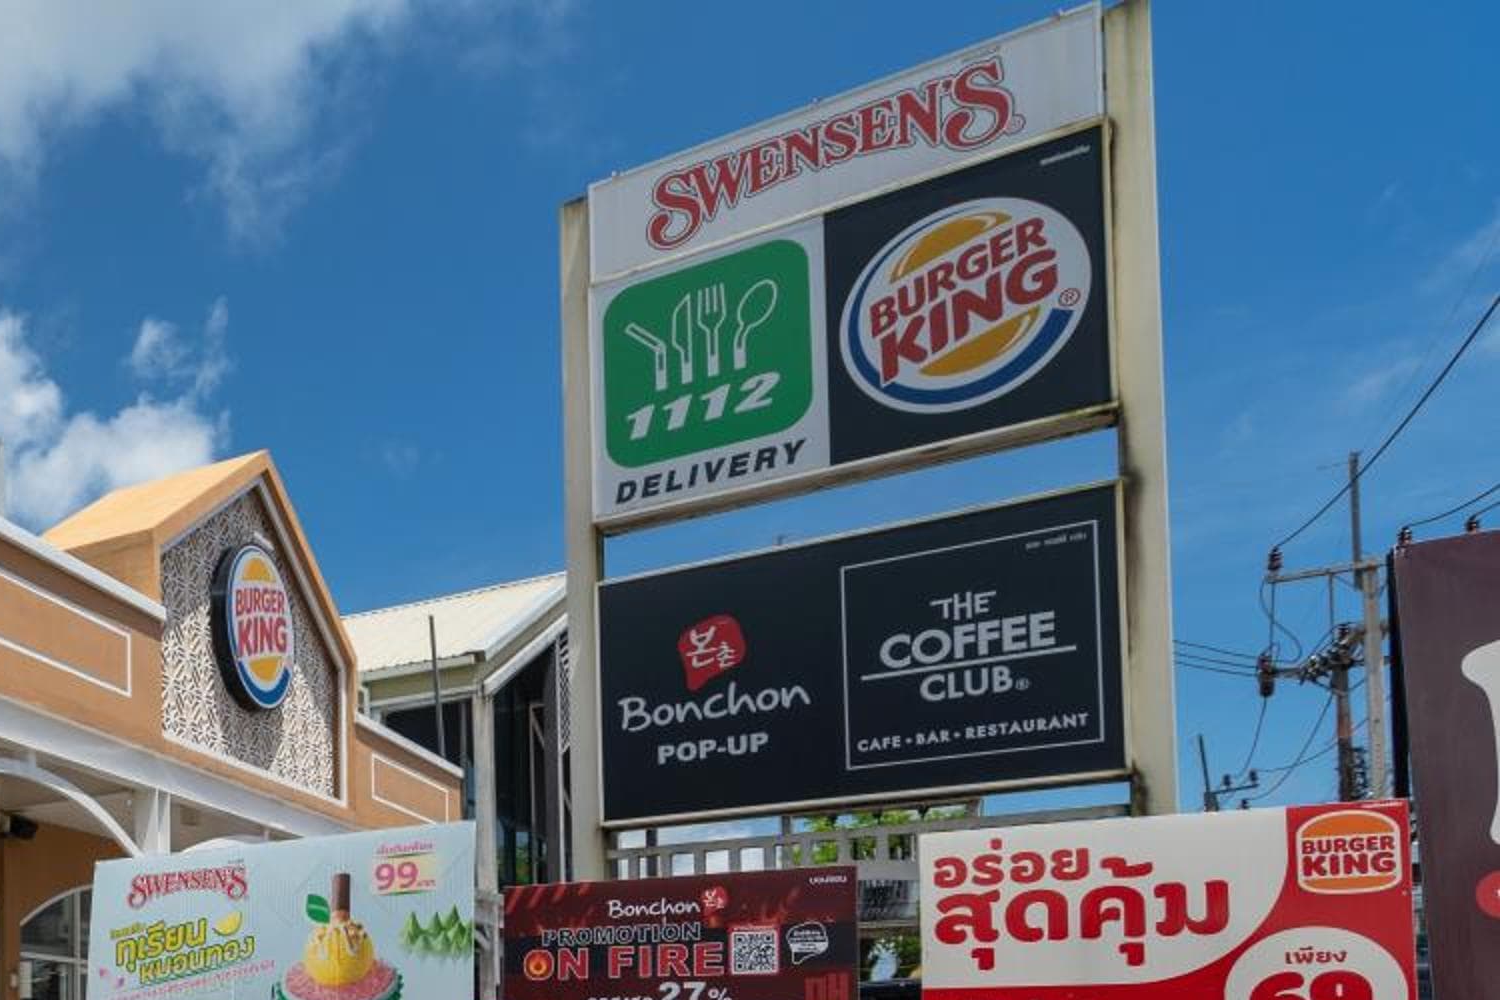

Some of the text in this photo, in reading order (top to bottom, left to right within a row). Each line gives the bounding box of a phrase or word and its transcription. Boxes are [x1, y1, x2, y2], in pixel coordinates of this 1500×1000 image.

[646, 58, 1016, 250] SWENSEN'S
[870, 216, 1048, 339] BURGER
[879, 248, 1060, 387] KING
[626, 371, 782, 441] 1112
[615, 439, 806, 505] DELIVERY
[235, 588, 285, 617] BURGER
[930, 590, 997, 622] THE
[238, 615, 287, 657] KING
[879, 611, 1056, 670] COFFEE
[920, 665, 1015, 702] CLUB
[618, 681, 811, 732] Bonchon
[657, 732, 769, 765] POP-UP
[857, 712, 1090, 753] CAFE BAR RESTAURANT
[933, 837, 1089, 889] อร่อย
[1301, 835, 1395, 855] BURGER
[1301, 851, 1397, 877] KING
[127, 865, 248, 909] SWENSEN'S
[375, 861, 419, 891] 99
[608, 897, 701, 920] Bonchon
[933, 856, 1230, 972] สุดคุ้ม
[541, 921, 702, 948] PROMOTION
[523, 941, 725, 981] ON FIRE
[1285, 946, 1347, 967] เพียง
